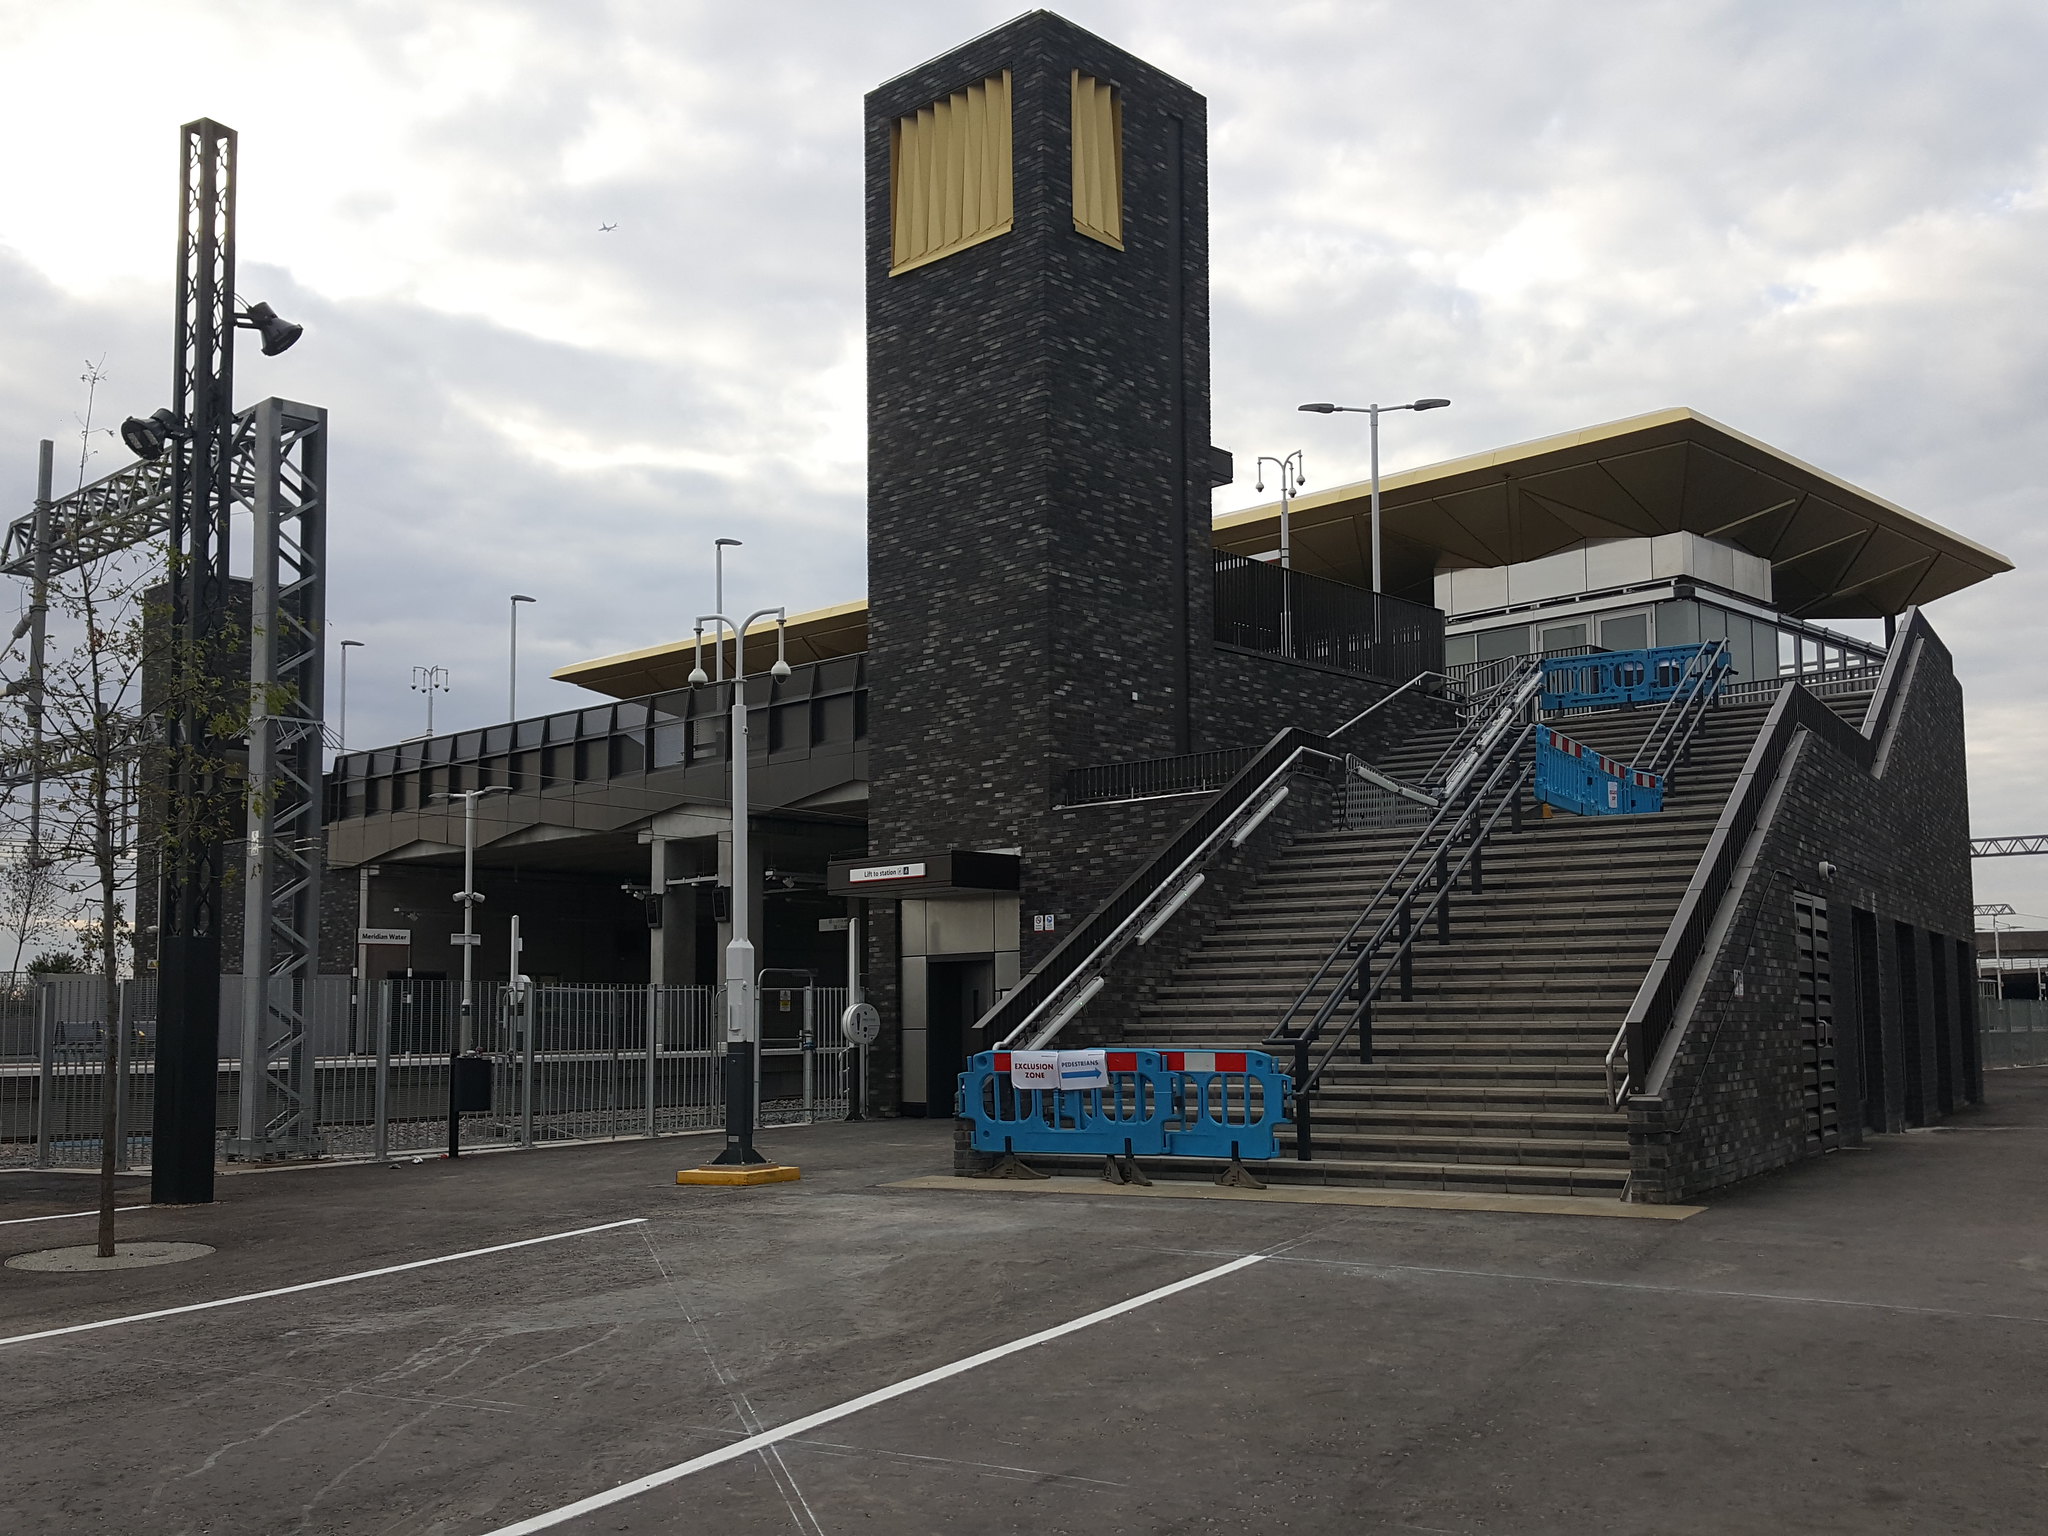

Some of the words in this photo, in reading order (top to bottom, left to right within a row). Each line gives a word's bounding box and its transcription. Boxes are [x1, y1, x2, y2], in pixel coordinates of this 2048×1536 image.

[864, 870, 873, 878] Lift
[880, 868, 896, 877] station
[1061, 1060, 1099, 1068] PEDESTRIANS
[1024, 1071, 1046, 1079] ZONE
